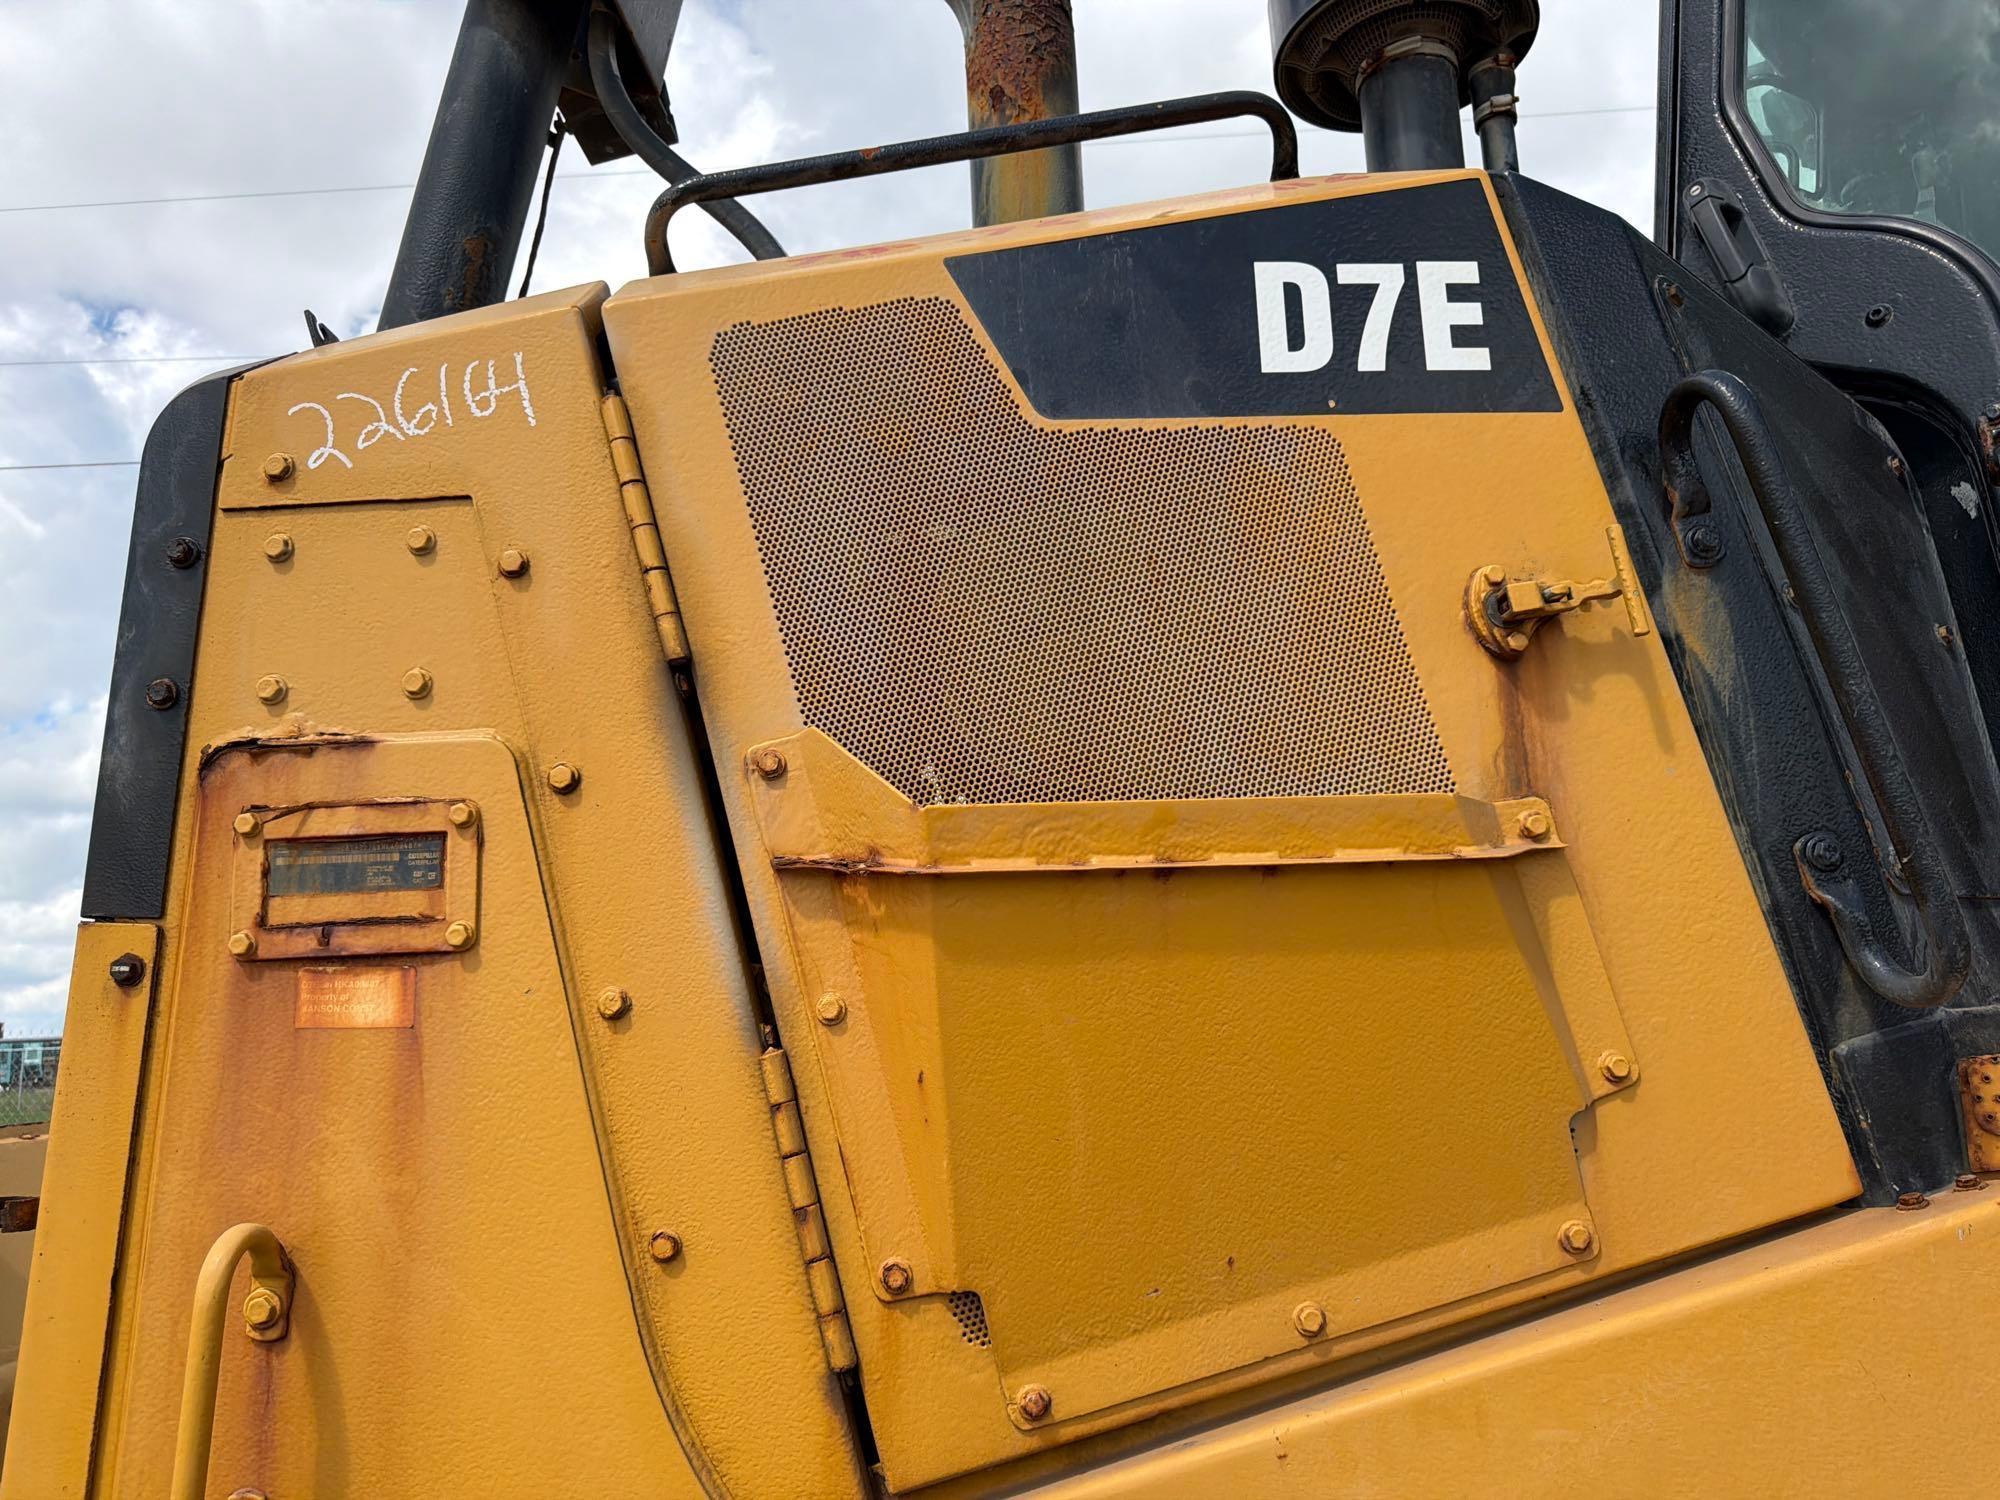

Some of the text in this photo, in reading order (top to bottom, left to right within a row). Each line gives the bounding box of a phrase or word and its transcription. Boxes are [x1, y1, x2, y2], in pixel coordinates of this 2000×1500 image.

[1253, 261, 1491, 373] D7E
[287, 352, 537, 469] 226164
[340, 992, 350, 1001] of
